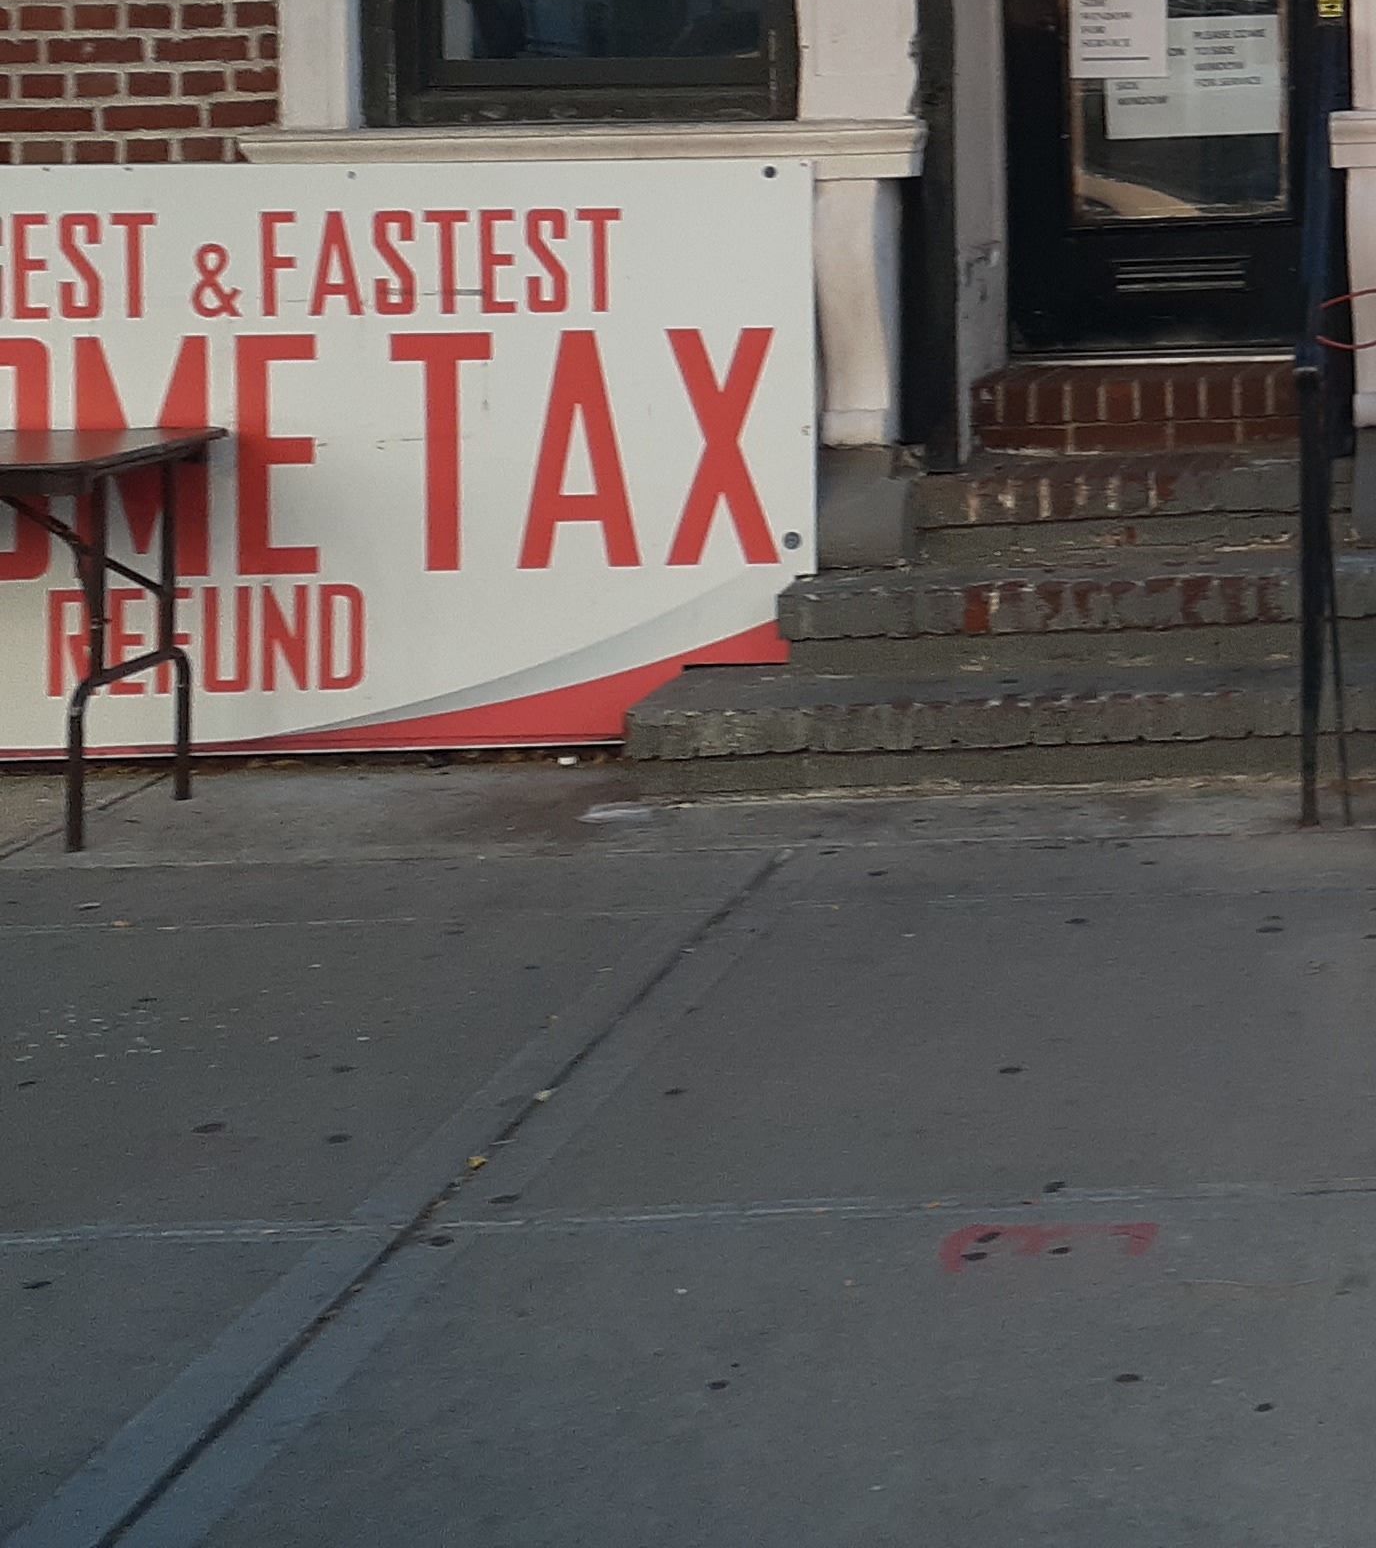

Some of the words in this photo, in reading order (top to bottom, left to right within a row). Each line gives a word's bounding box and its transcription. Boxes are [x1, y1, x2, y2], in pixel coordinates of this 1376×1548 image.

[0, 213, 157, 319] EST
[192, 244, 241, 317] &
[261, 208, 621, 316] FASTEST
[391, 328, 778, 571] TAX
